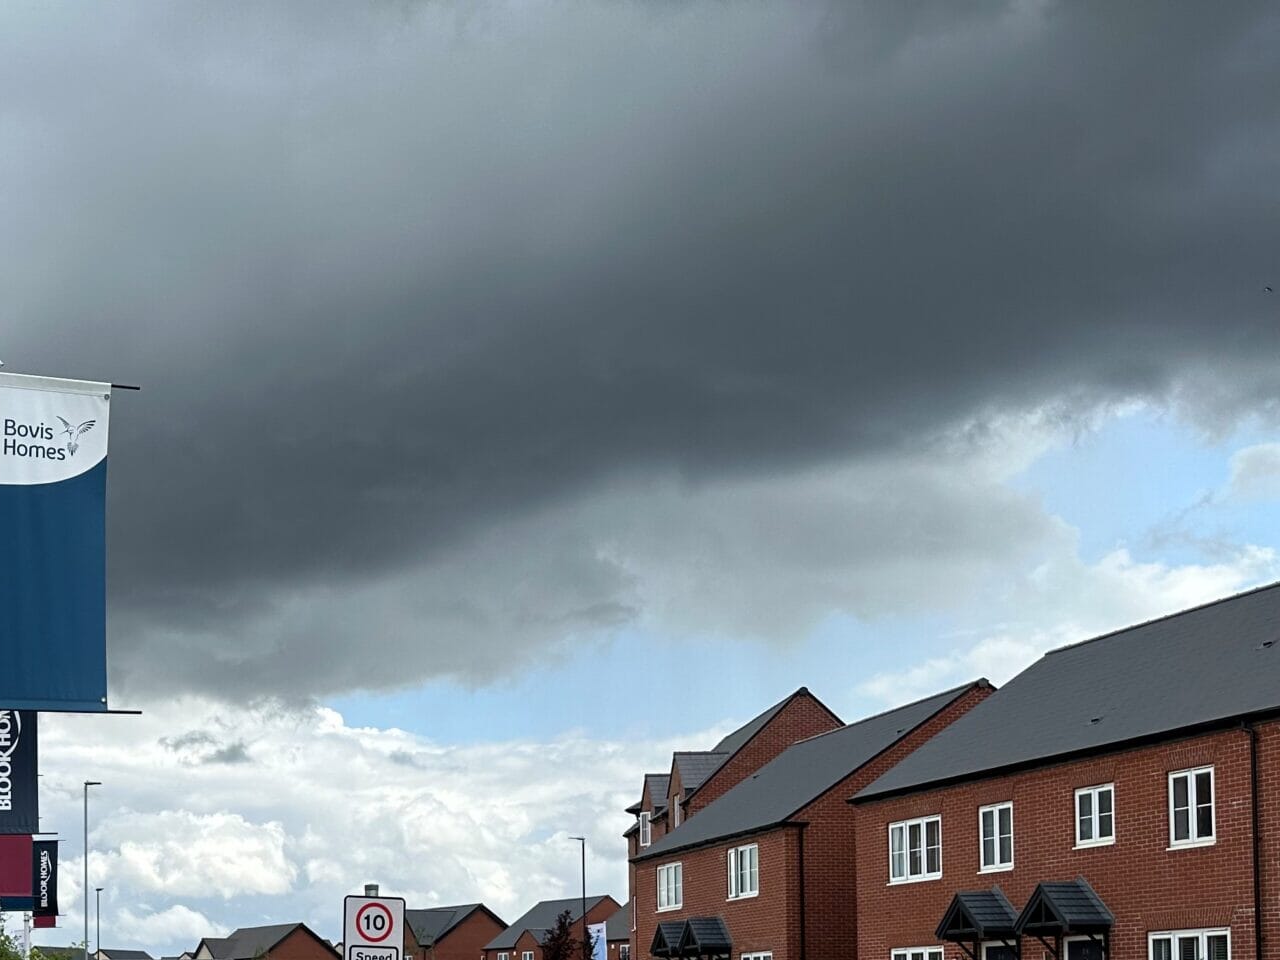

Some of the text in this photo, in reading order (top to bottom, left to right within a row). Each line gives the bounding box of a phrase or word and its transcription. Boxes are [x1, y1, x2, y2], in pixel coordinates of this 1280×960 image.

[4, 418, 53, 440] Bovis
[3, 438, 66, 461] Homes
[40, 850, 48, 907] BLOOR HOMES
[364, 914, 386, 931] 10
